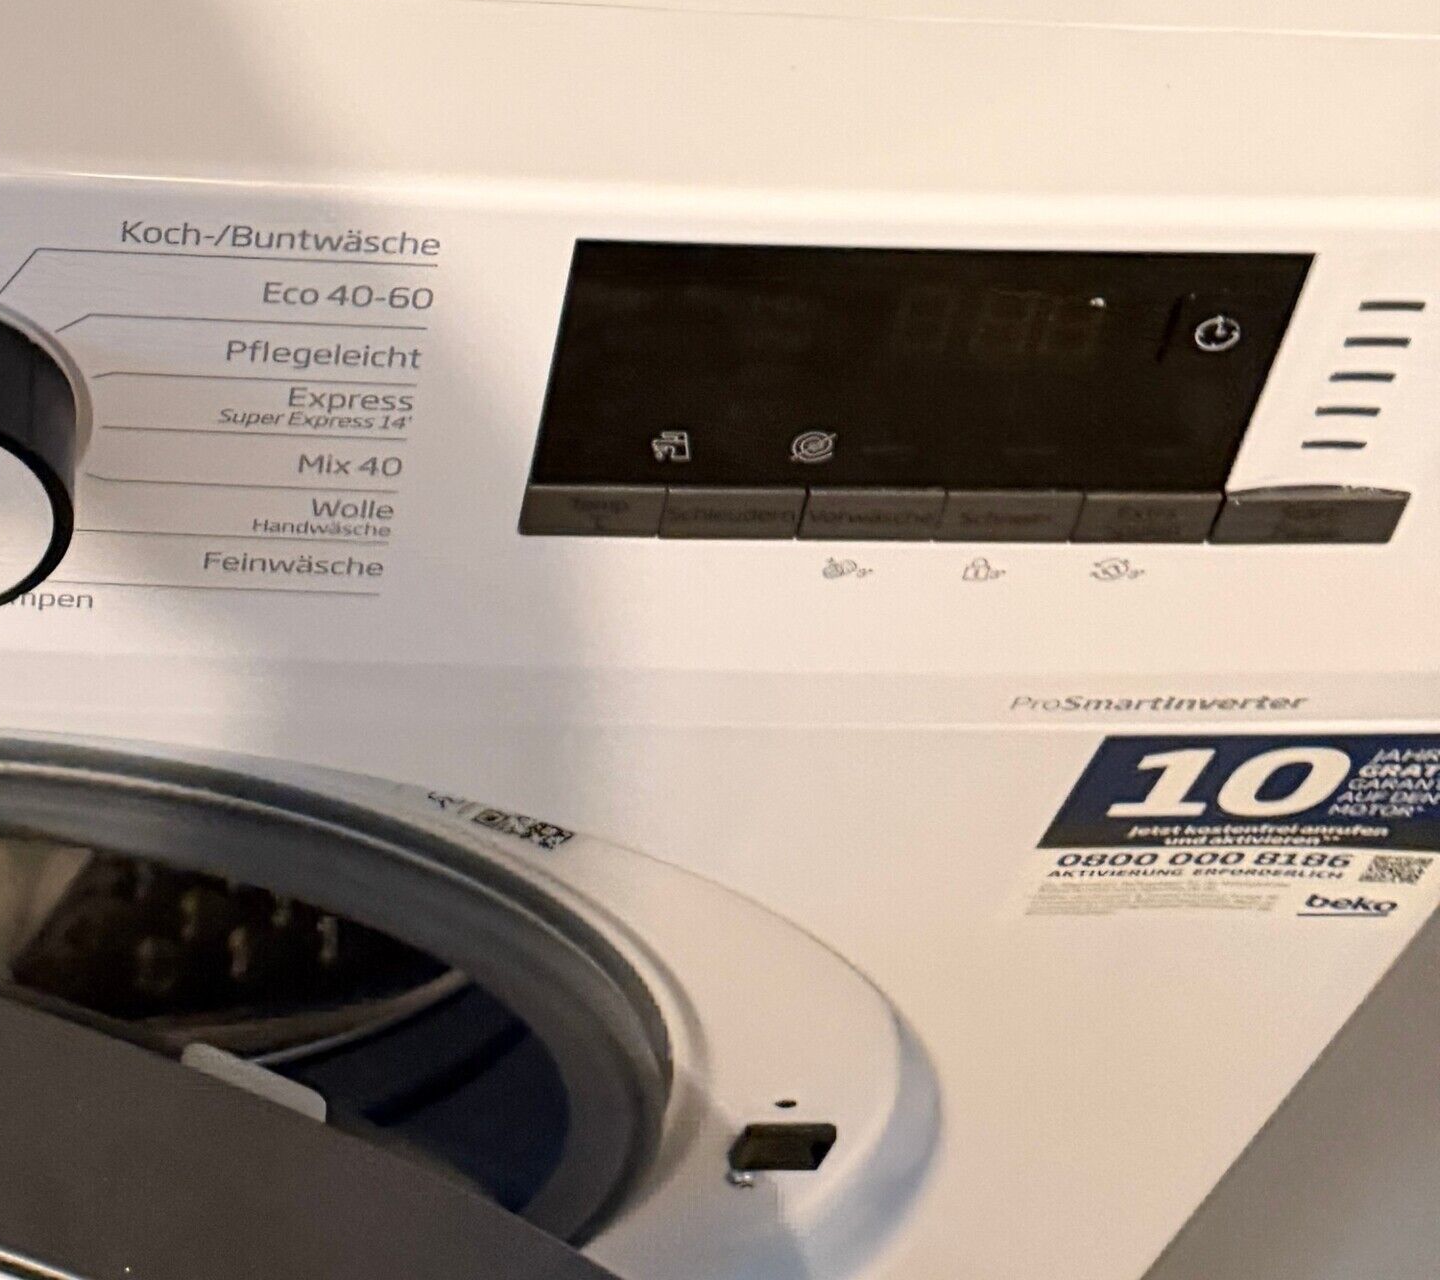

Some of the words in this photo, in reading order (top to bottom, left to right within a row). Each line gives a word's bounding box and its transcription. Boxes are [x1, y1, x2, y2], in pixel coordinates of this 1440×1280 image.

[121, 220, 441, 257] Koch-/Buntwäsche
[262, 281, 319, 306] Eco
[327, 284, 434, 310] 40-60
[225, 339, 422, 369] Pflegeleicht
[288, 386, 414, 412] Express
[218, 408, 284, 429] Super
[289, 411, 374, 430] Express
[298, 453, 350, 476] Mix
[359, 456, 402, 477] 40
[312, 498, 395, 520] Wolle
[252, 519, 391, 538] Handwäsche
[204, 551, 384, 577] Feinwäsche
[1106, 746, 1351, 818] 10
[1056, 852, 1159, 868] 0800
[1168, 852, 1245, 867] 000
[1254, 852, 1356, 868] 8186
[1047, 868, 1183, 878] AKTIVIERUNG
[1192, 868, 1345, 880] ERFORDERLICH
[1305, 893, 1398, 912] beko
